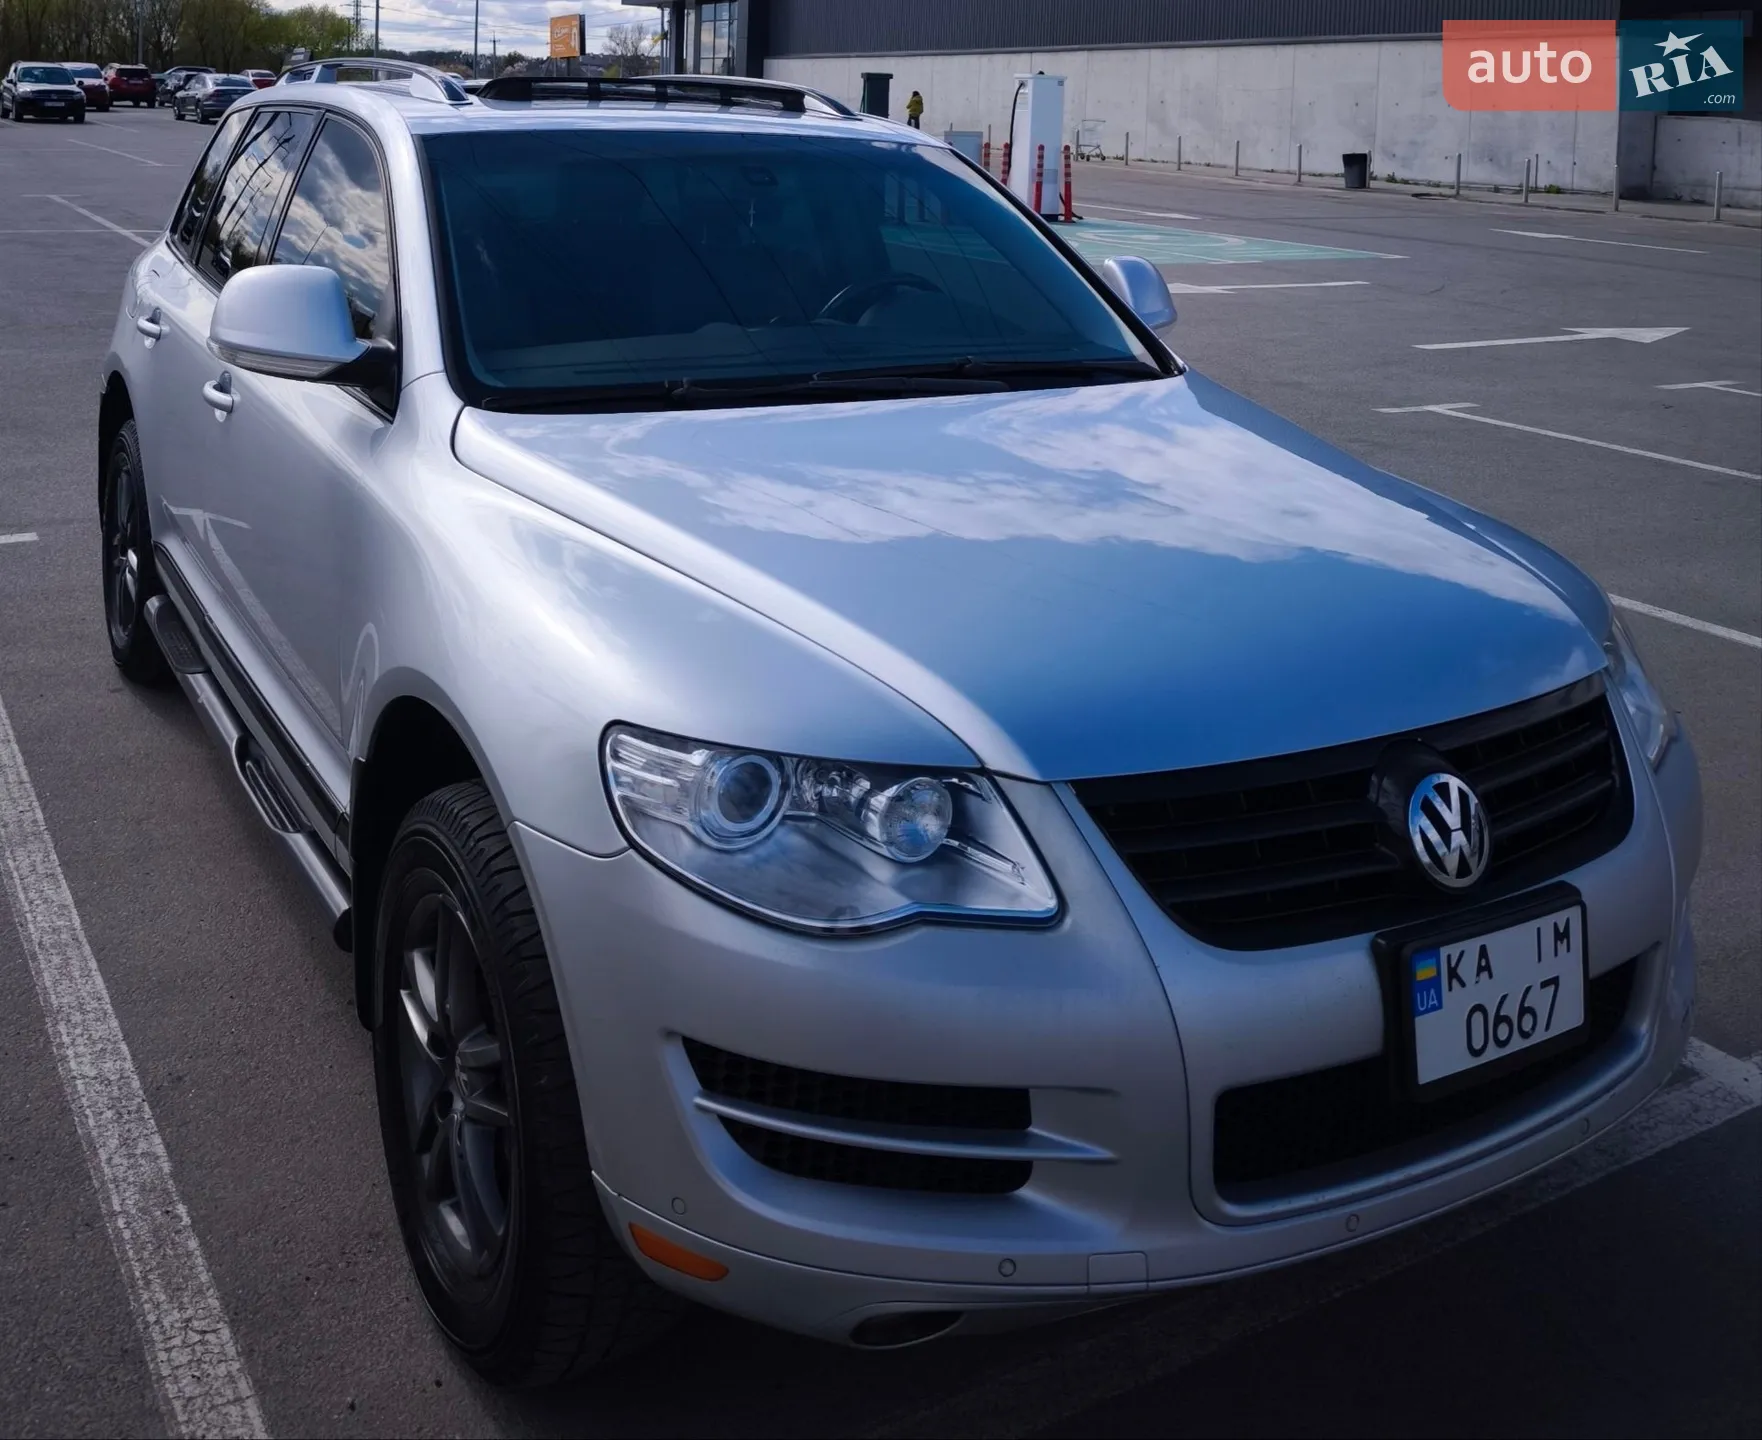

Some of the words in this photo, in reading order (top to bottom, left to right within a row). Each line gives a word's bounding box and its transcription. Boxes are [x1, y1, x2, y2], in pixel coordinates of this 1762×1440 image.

[1446, 944, 1493, 992] KA
[1536, 917, 1571, 963] IM
[1416, 989, 1439, 1011] UA
[1465, 975, 1560, 1058] 0667
